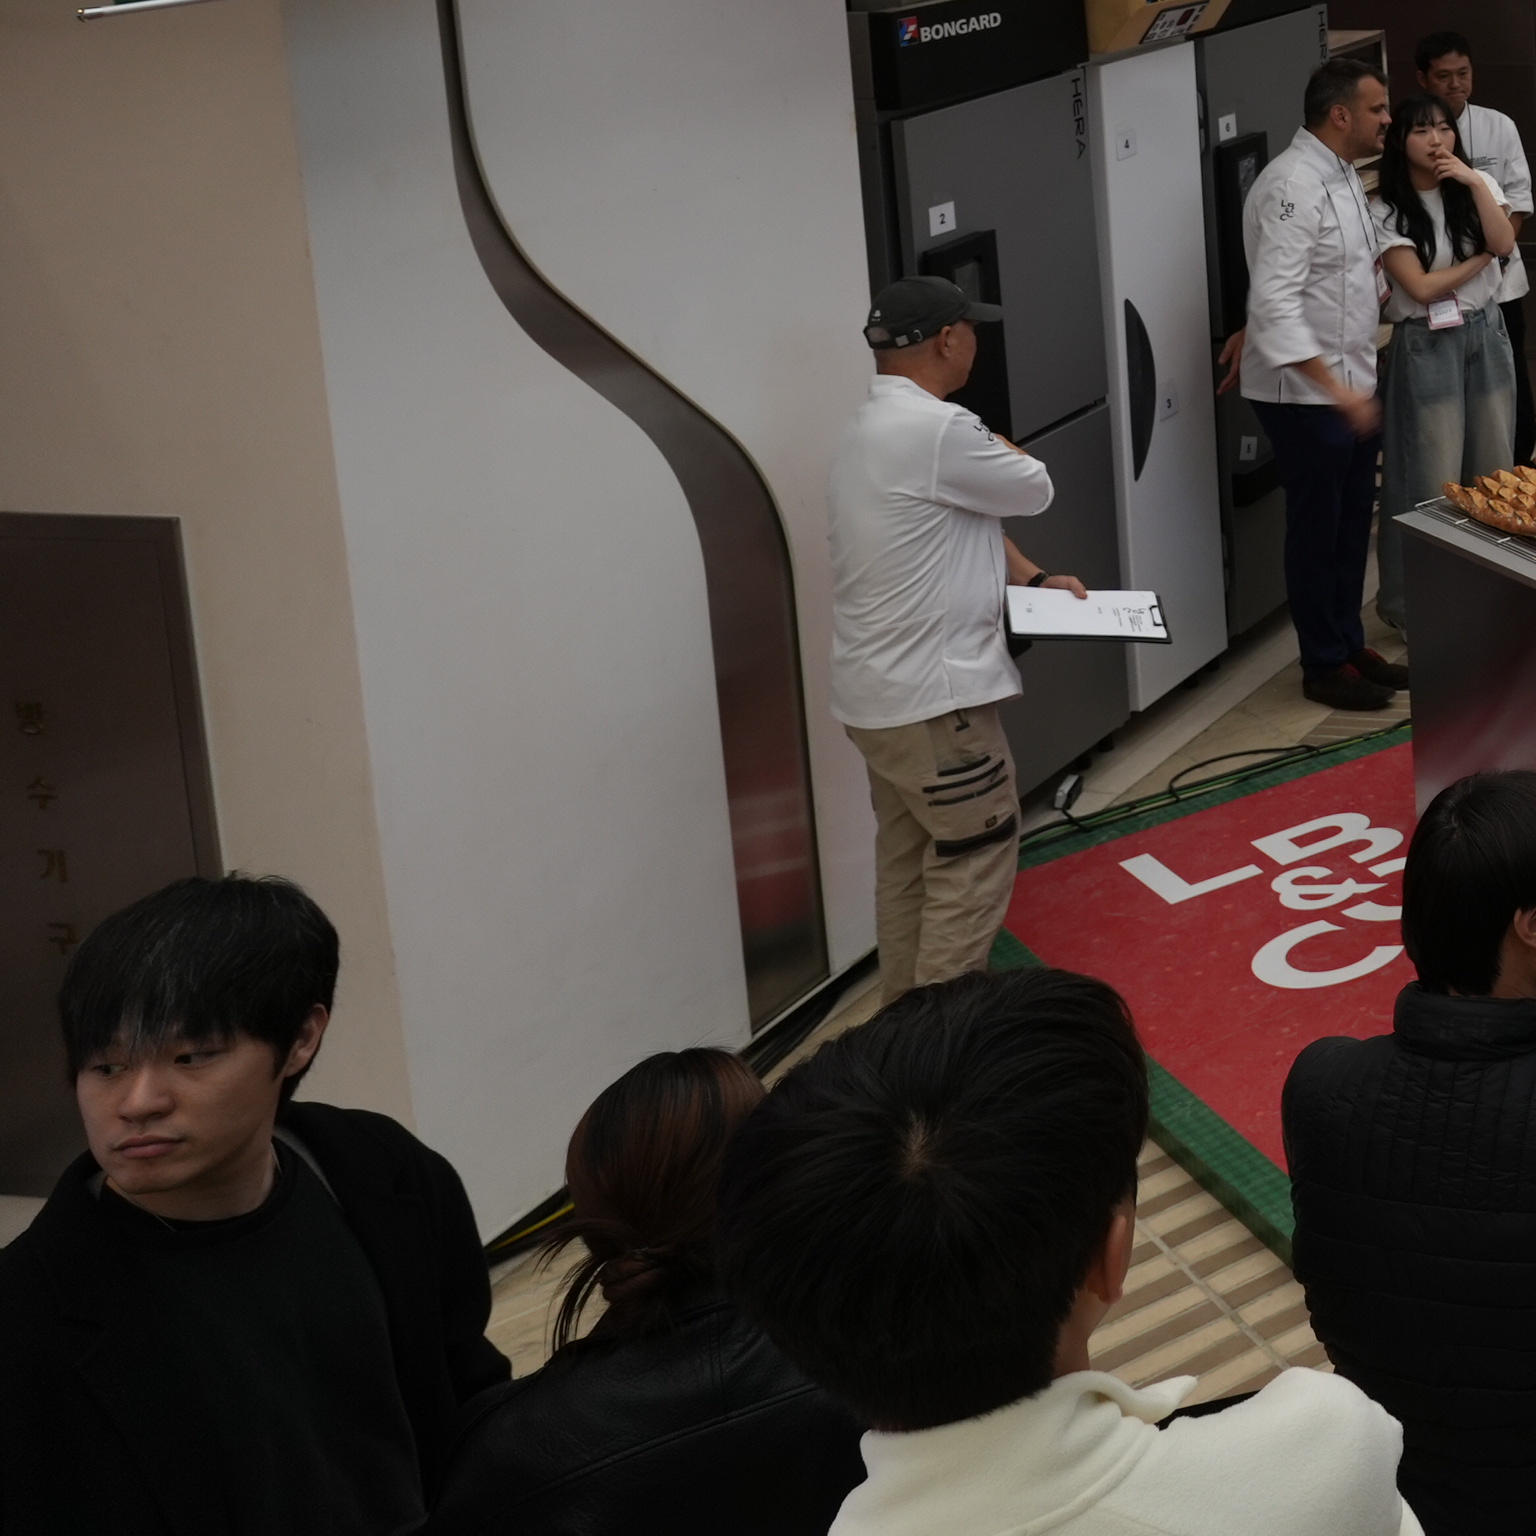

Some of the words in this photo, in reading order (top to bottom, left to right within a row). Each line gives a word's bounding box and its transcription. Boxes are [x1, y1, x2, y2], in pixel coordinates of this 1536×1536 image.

[919, 11, 1002, 43] BONGARD
[1317, 10, 1328, 65] HER
[1070, 76, 1087, 160] HERA
[1225, 122, 1231, 132] 6
[1123, 138, 1130, 150] 4
[939, 213, 946, 224] 2
[1165, 398, 1173, 411] 3
